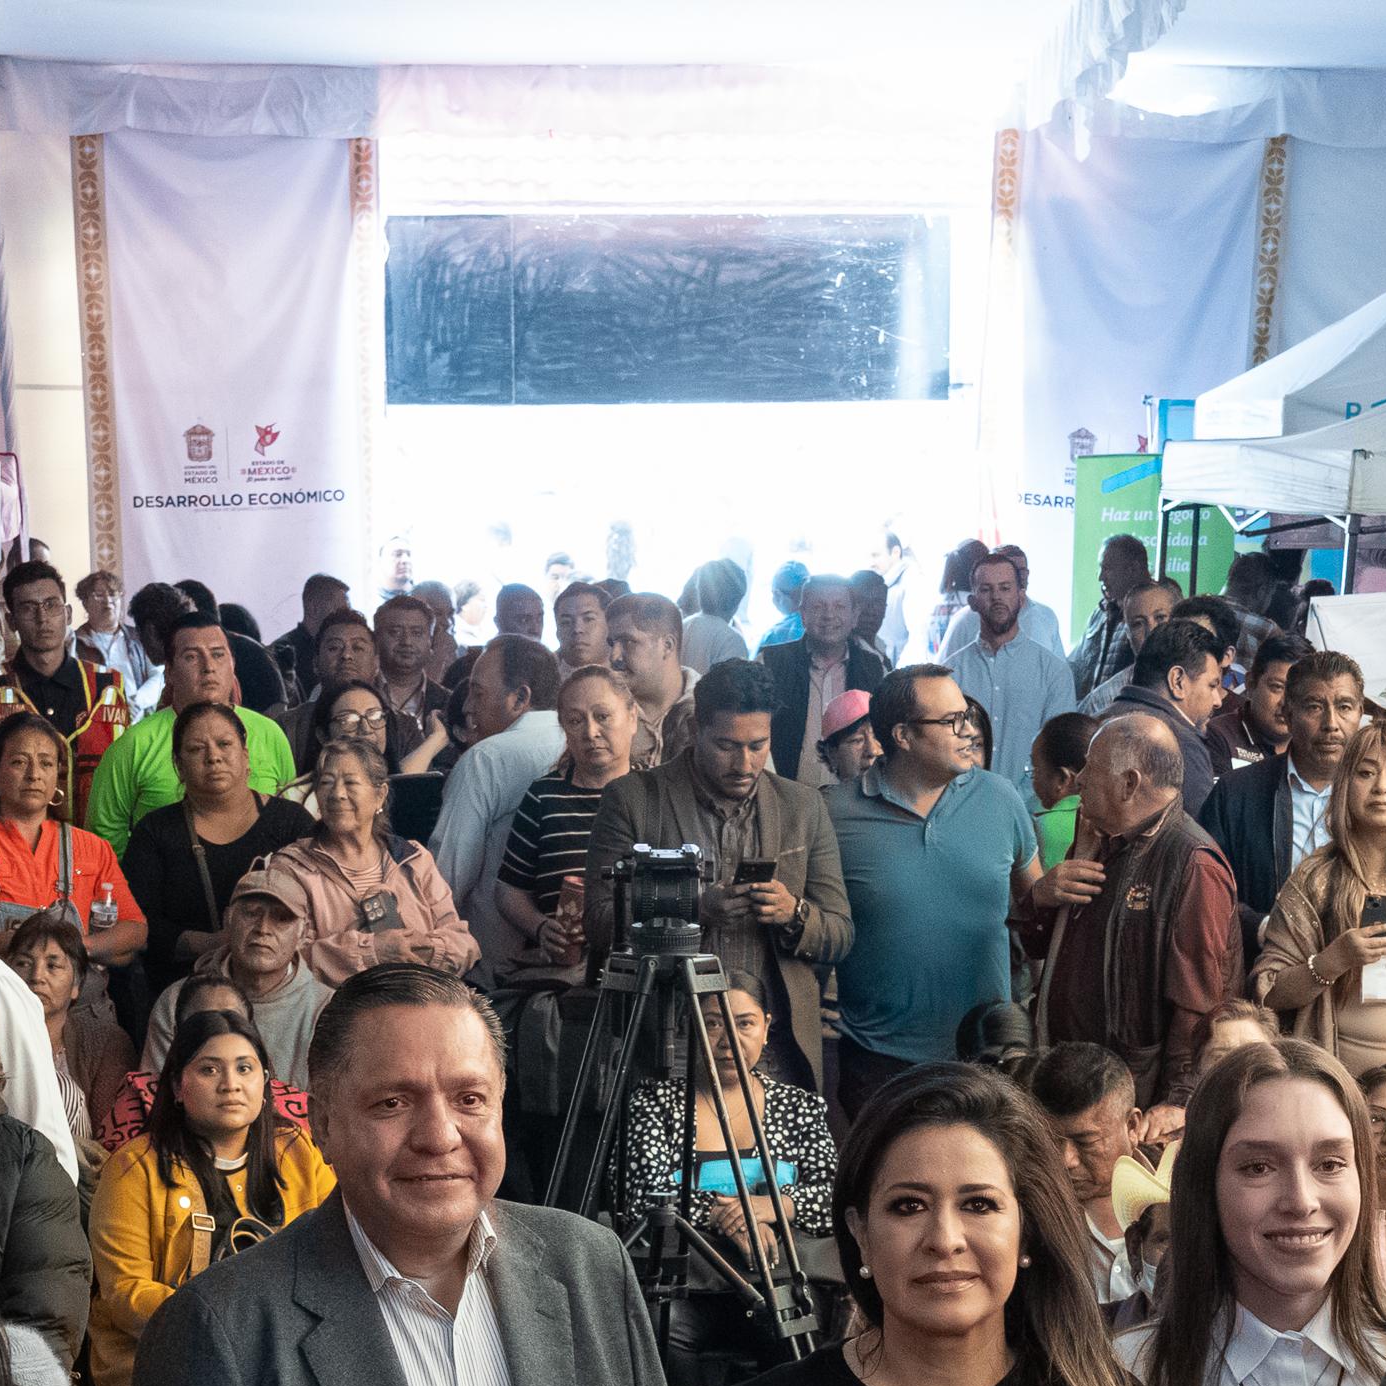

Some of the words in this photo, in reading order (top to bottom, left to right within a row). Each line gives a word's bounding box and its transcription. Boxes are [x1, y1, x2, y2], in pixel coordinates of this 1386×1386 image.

[132, 493, 243, 509] DESARROLLO
[248, 488, 345, 506] ECONÓMICO
[1101, 508, 1131, 522] Haz
[1134, 510, 1153, 521] un
[102, 706, 127, 723] IVAN
